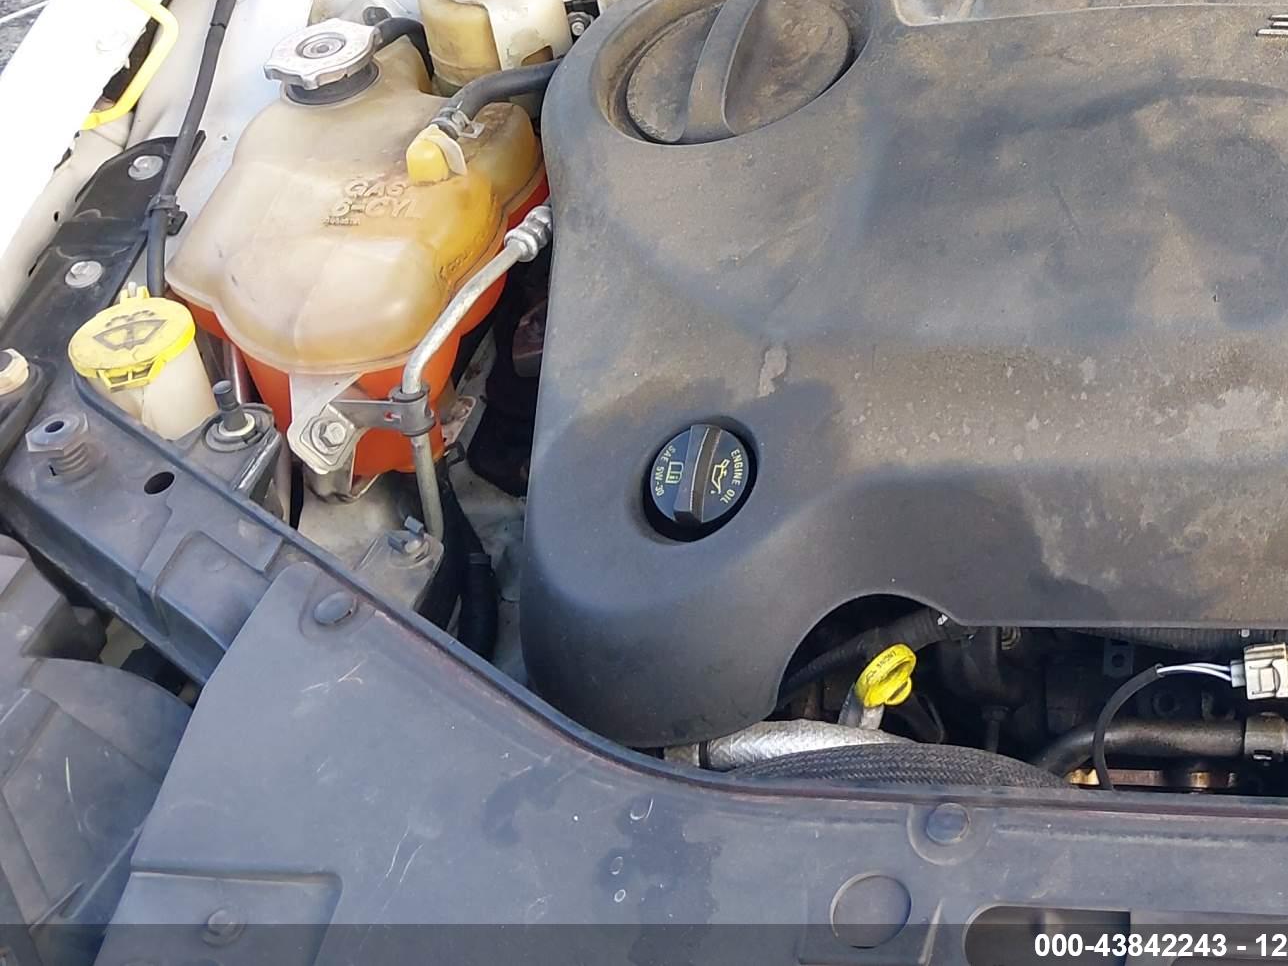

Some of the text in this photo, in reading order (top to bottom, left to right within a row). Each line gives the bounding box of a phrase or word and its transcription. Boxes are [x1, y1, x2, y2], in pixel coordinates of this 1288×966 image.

[654, 445, 677, 497] SAE 5W-30
[719, 449, 744, 504] ENGINE OIL
